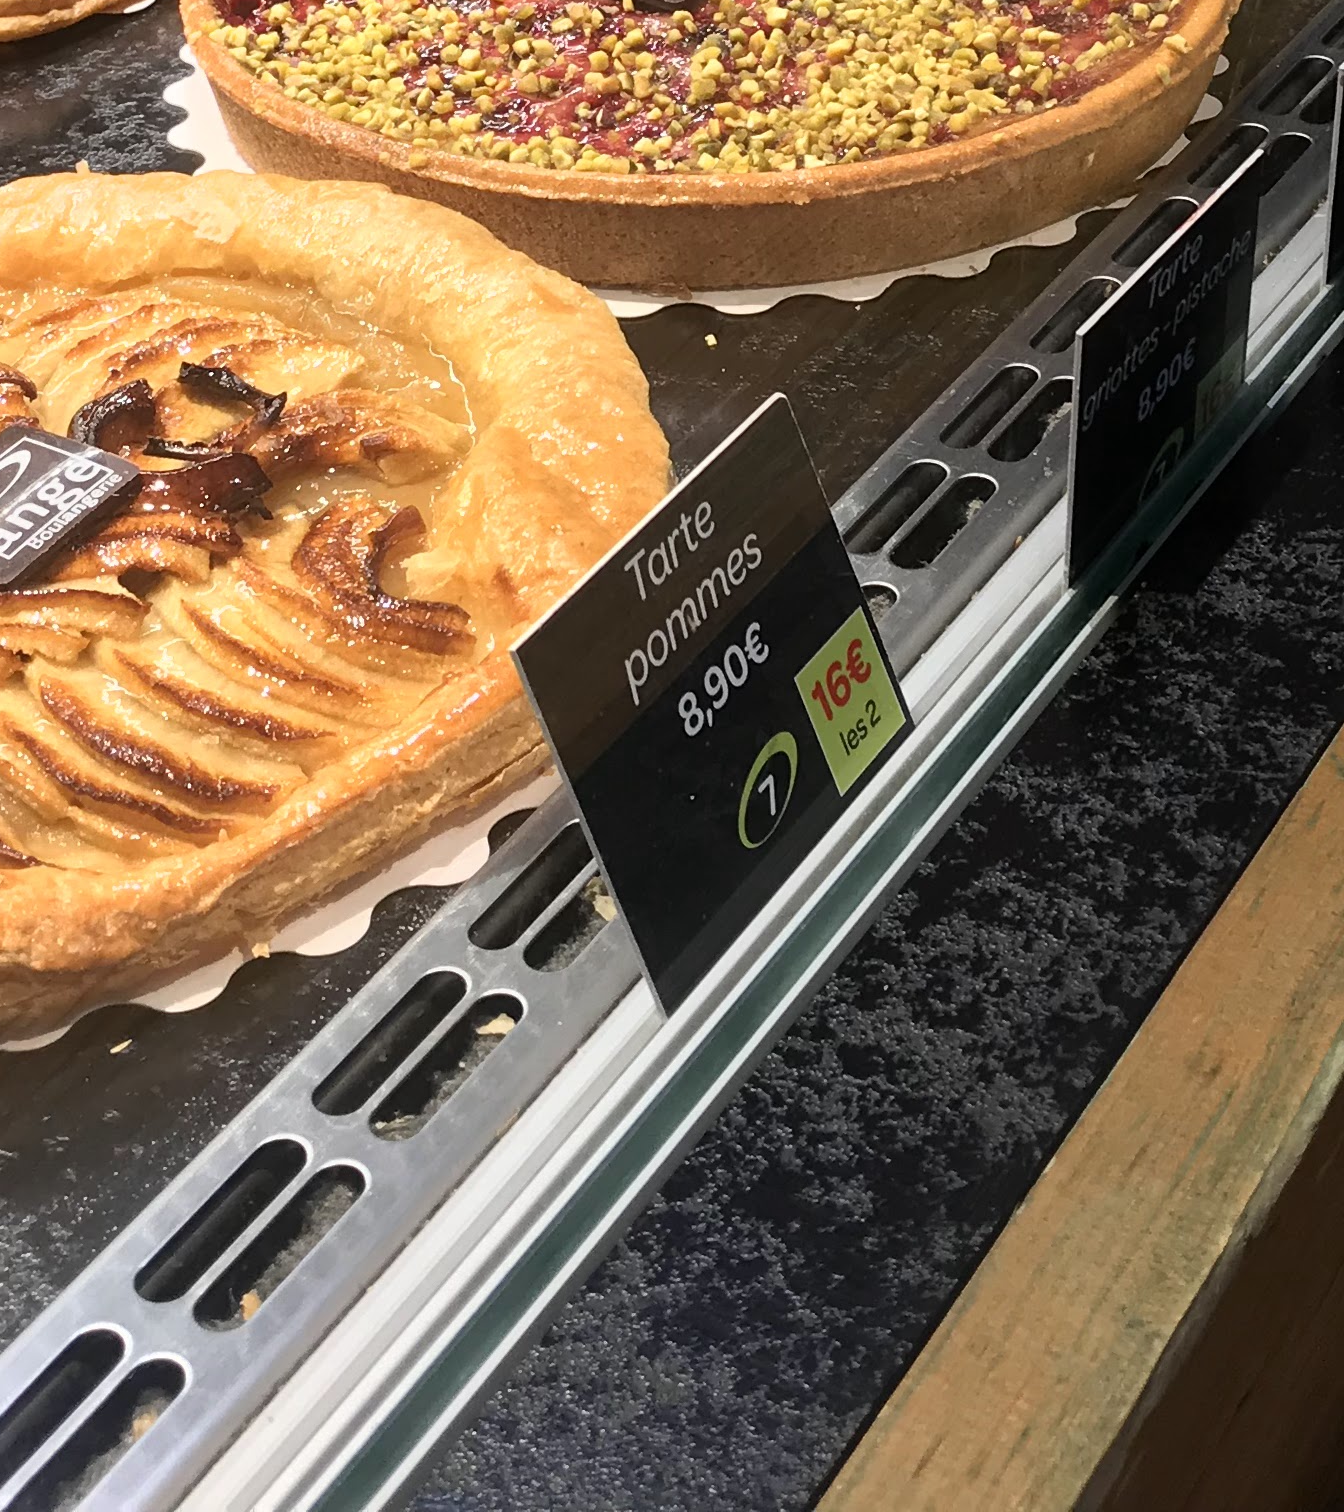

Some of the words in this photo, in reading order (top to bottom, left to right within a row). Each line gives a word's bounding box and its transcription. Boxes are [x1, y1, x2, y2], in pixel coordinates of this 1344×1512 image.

[1148, 234, 1204, 309] Tarte
[1081, 327, 1160, 433] griottes
[1171, 230, 1253, 337] pistache
[1137, 337, 1198, 423] 8,90€
[27, 472, 124, 550] Boulangerie
[624, 500, 716, 602] Tarte
[624, 531, 763, 707] pommes
[677, 621, 771, 737] 8,90€
[811, 638, 872, 723] 16€
[839, 717, 869, 758] les
[864, 706, 883, 735] 2
[757, 774, 779, 818] 7
